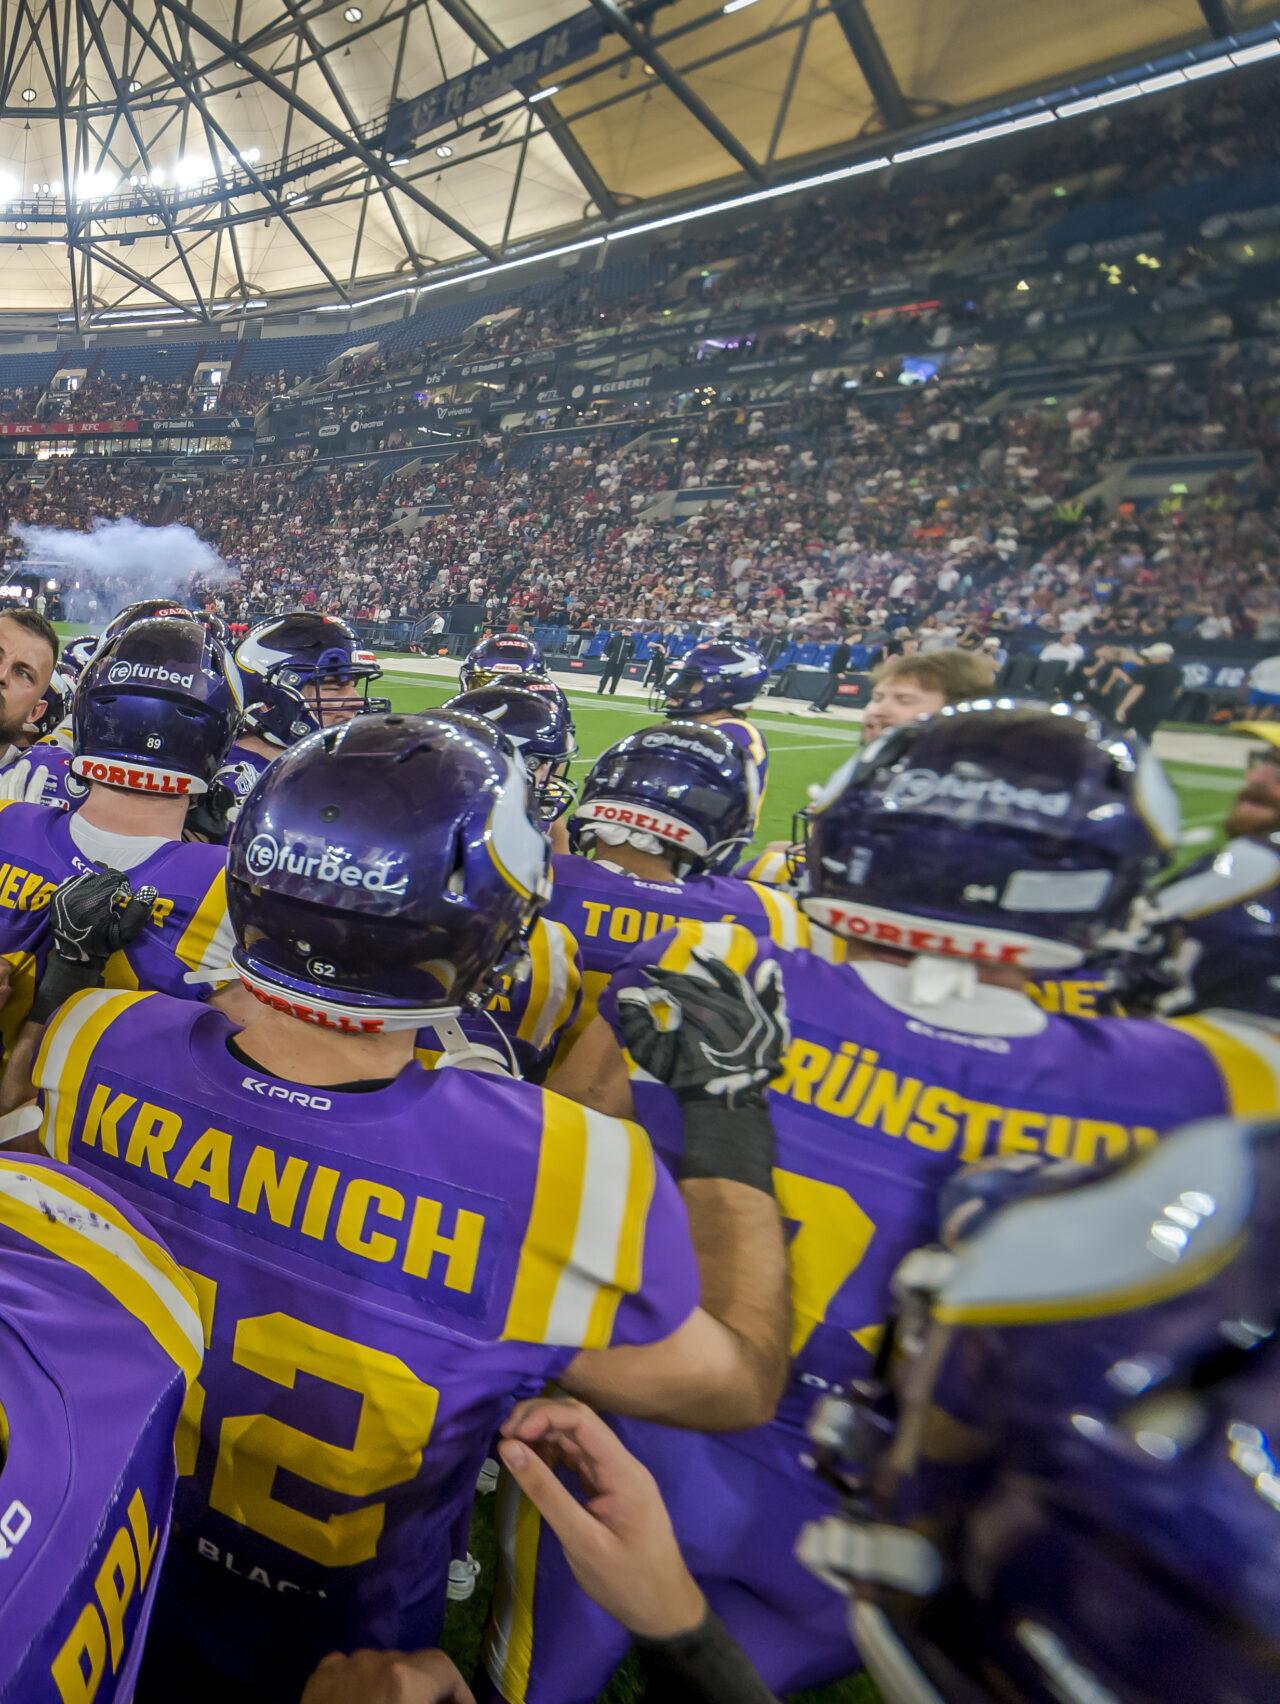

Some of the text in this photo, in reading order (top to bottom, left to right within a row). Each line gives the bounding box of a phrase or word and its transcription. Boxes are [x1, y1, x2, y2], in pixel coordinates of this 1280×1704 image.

[425, 374, 441, 385] bfs
[602, 376, 652, 393] GEBERIT
[15, 425, 32, 433] KFC
[81, 423, 99, 432] KFC
[109, 661, 194, 689] refurbed
[146, 737, 162, 750] 89
[81, 760, 192, 795] FORELLE
[593, 805, 691, 842] FORELLE
[247, 835, 391, 892] refurbed
[313, 962, 337, 978] 52
[81, 1084, 486, 1295] KRANICH
